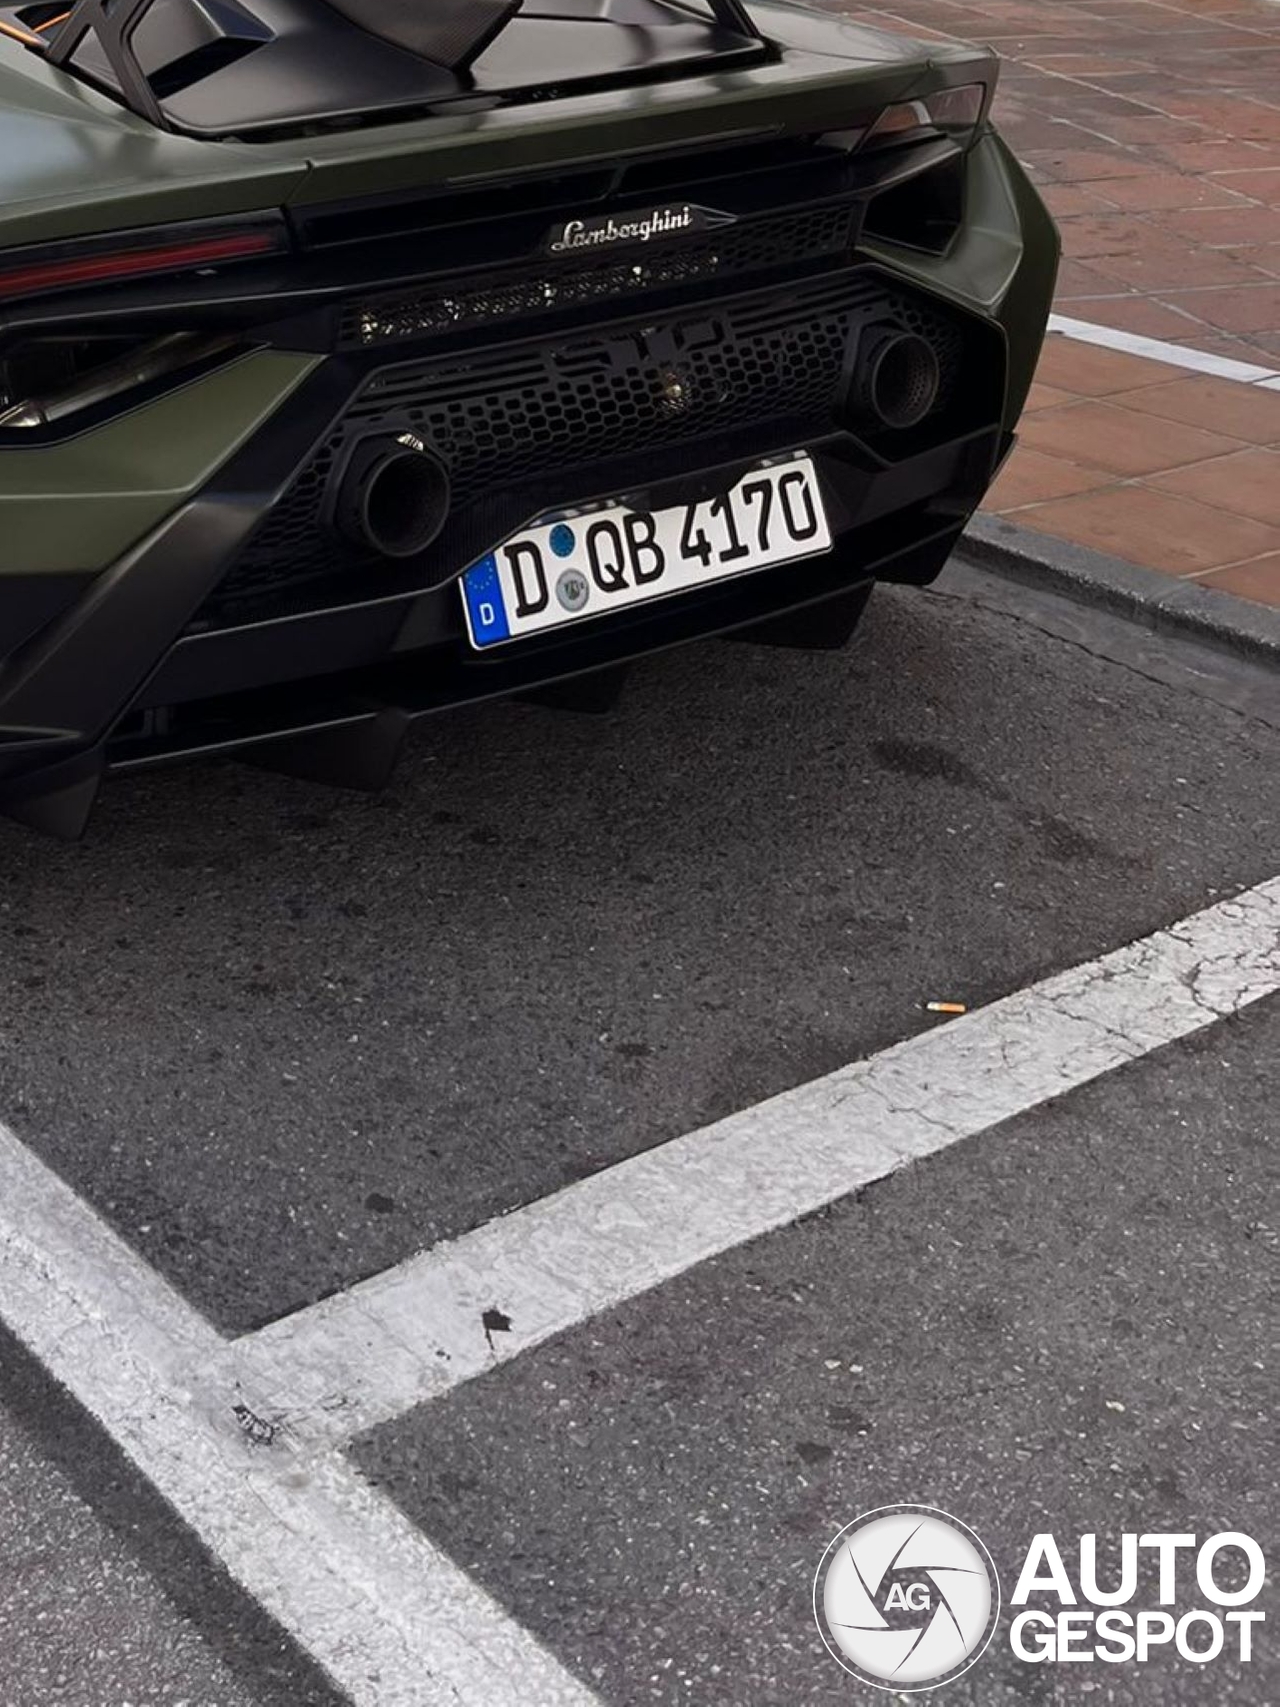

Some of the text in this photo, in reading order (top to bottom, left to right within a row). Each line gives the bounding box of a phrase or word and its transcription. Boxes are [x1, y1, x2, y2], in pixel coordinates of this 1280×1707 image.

[551, 205, 693, 251] Lamborghini
[504, 470, 817, 619] D QB 4170
[479, 602, 496, 626] D
